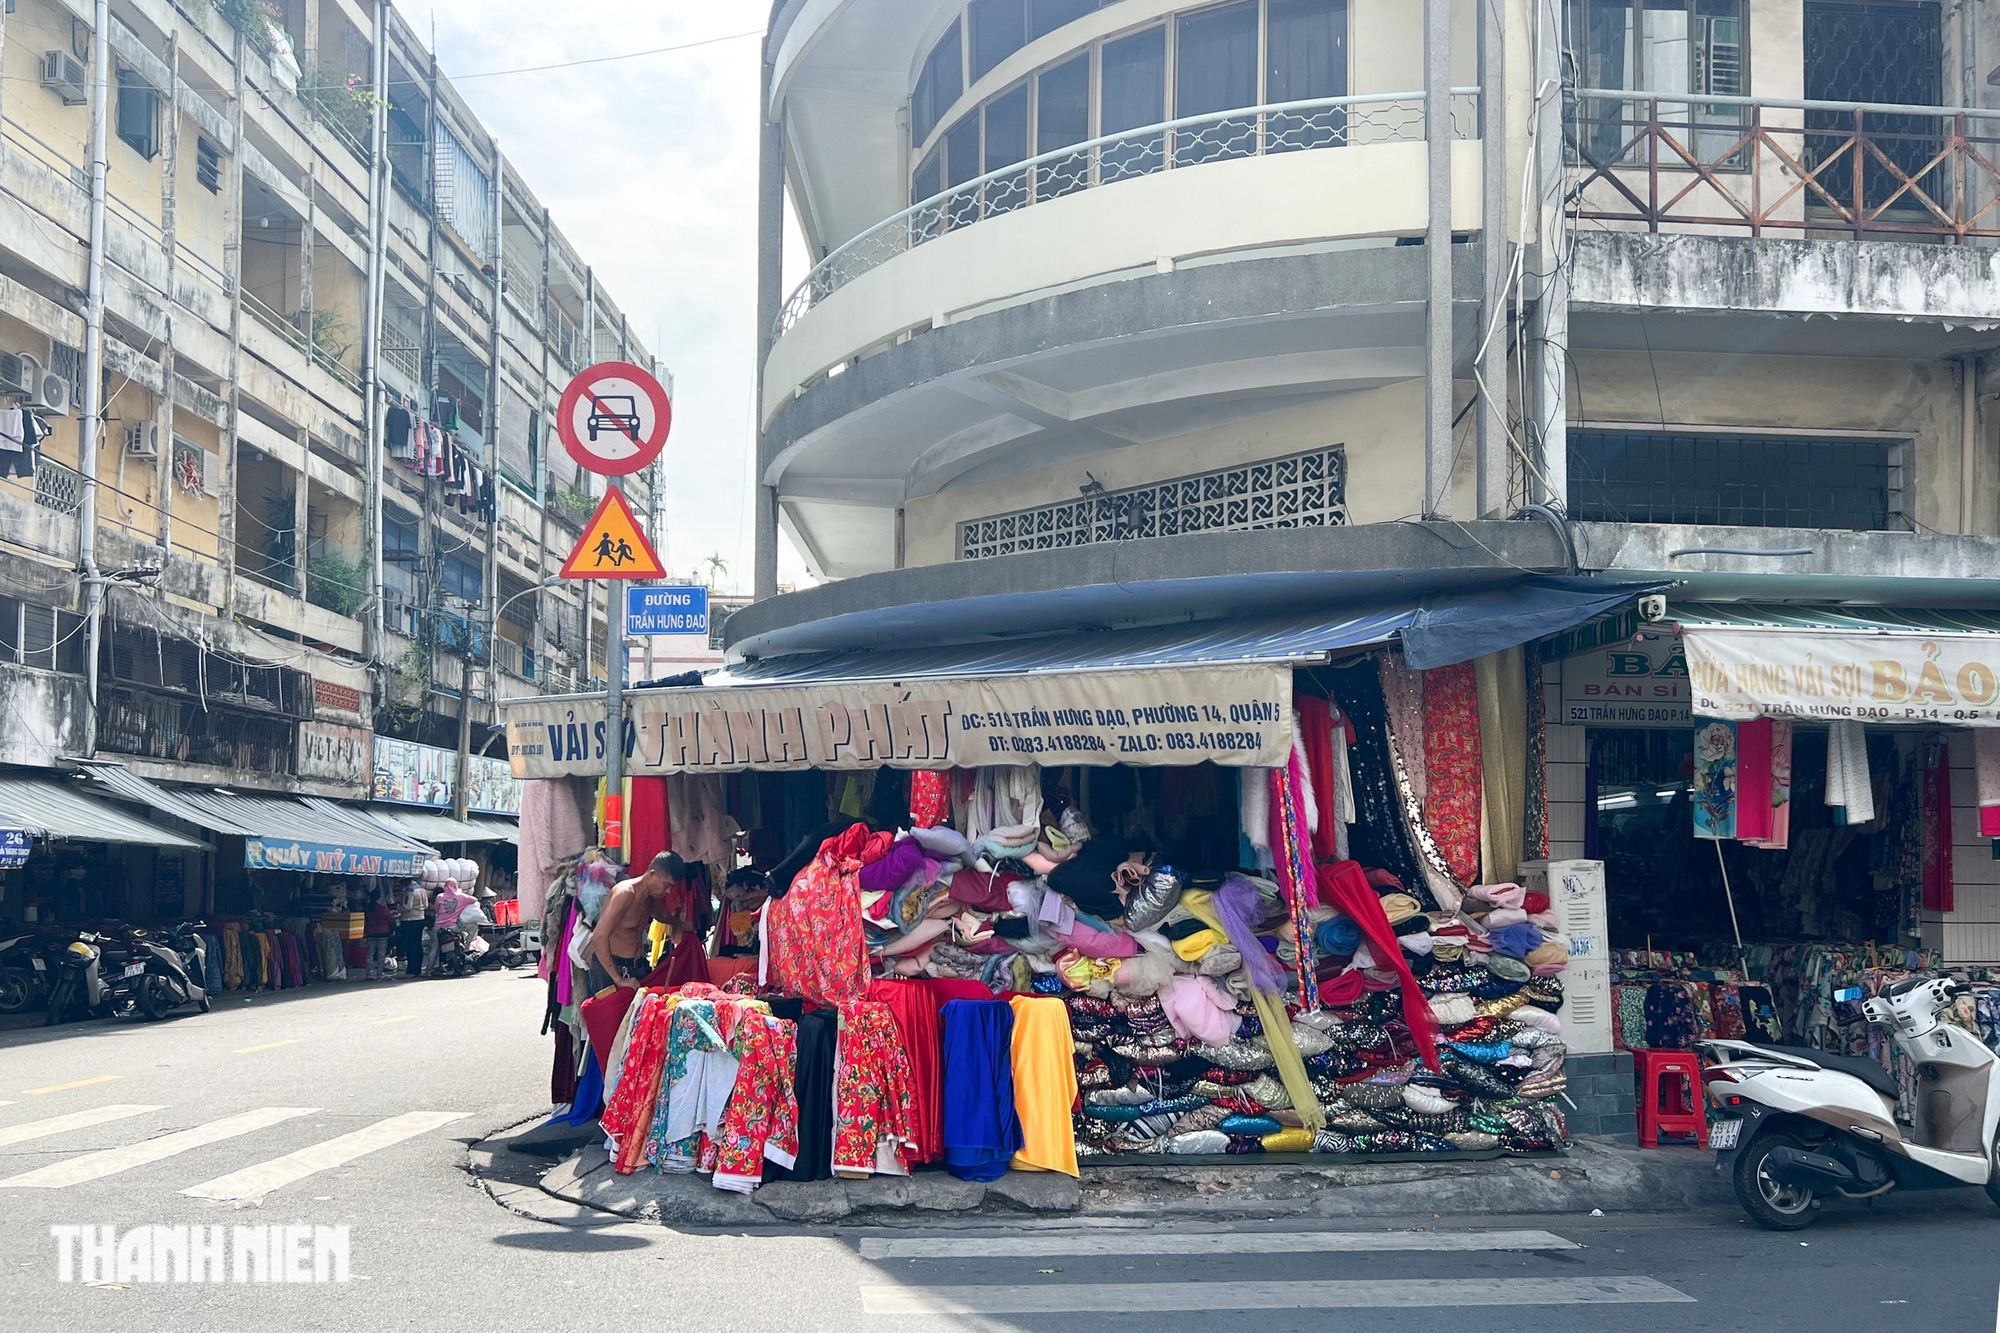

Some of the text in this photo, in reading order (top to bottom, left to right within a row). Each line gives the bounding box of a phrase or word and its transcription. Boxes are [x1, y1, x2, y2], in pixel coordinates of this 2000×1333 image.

[644, 592, 691, 606] ĐƯỜNG
[630, 609, 706, 632] TRẦN HƯNG ĐẠO
[1607, 643, 1690, 678] BẢ
[1734, 655, 1787, 696] HÀNG
[1791, 652, 1825, 697] VẢI
[1830, 661, 1862, 704] SỢI
[1868, 641, 2000, 707] BẢO
[1584, 682, 1678, 697] BÁN SỈ
[962, 699, 1280, 730] ĐC: 519 TRẦN HƯNG ĐẠO, PHƯỜNG 14, QUẬN 5
[1570, 707, 1589, 720] 521
[1619, 706, 1646, 721] HƯNG
[1648, 708, 1669, 723] ĐẠO
[1670, 709, 1689, 722] P.14
[1725, 703, 1755, 713] 521
[1809, 704, 1851, 717] HƯNG
[1856, 706, 1889, 719] ĐẠO
[1905, 708, 1938, 719] P.14
[1953, 709, 1979, 720] Q.5
[547, 710, 589, 761] VẢI
[641, 699, 808, 767] THÀNH
[818, 691, 952, 762] PHÁT
[988, 736, 1009, 751] ĐT:
[1011, 735, 1106, 753] 0283.4188284
[1118, 733, 1163, 752] ZALO:
[1165, 732, 1262, 750] 083.4188284
[5, 831, 24, 845] 26
[315, 848, 346, 871] MỸ
[349, 854, 382, 873] LAN
